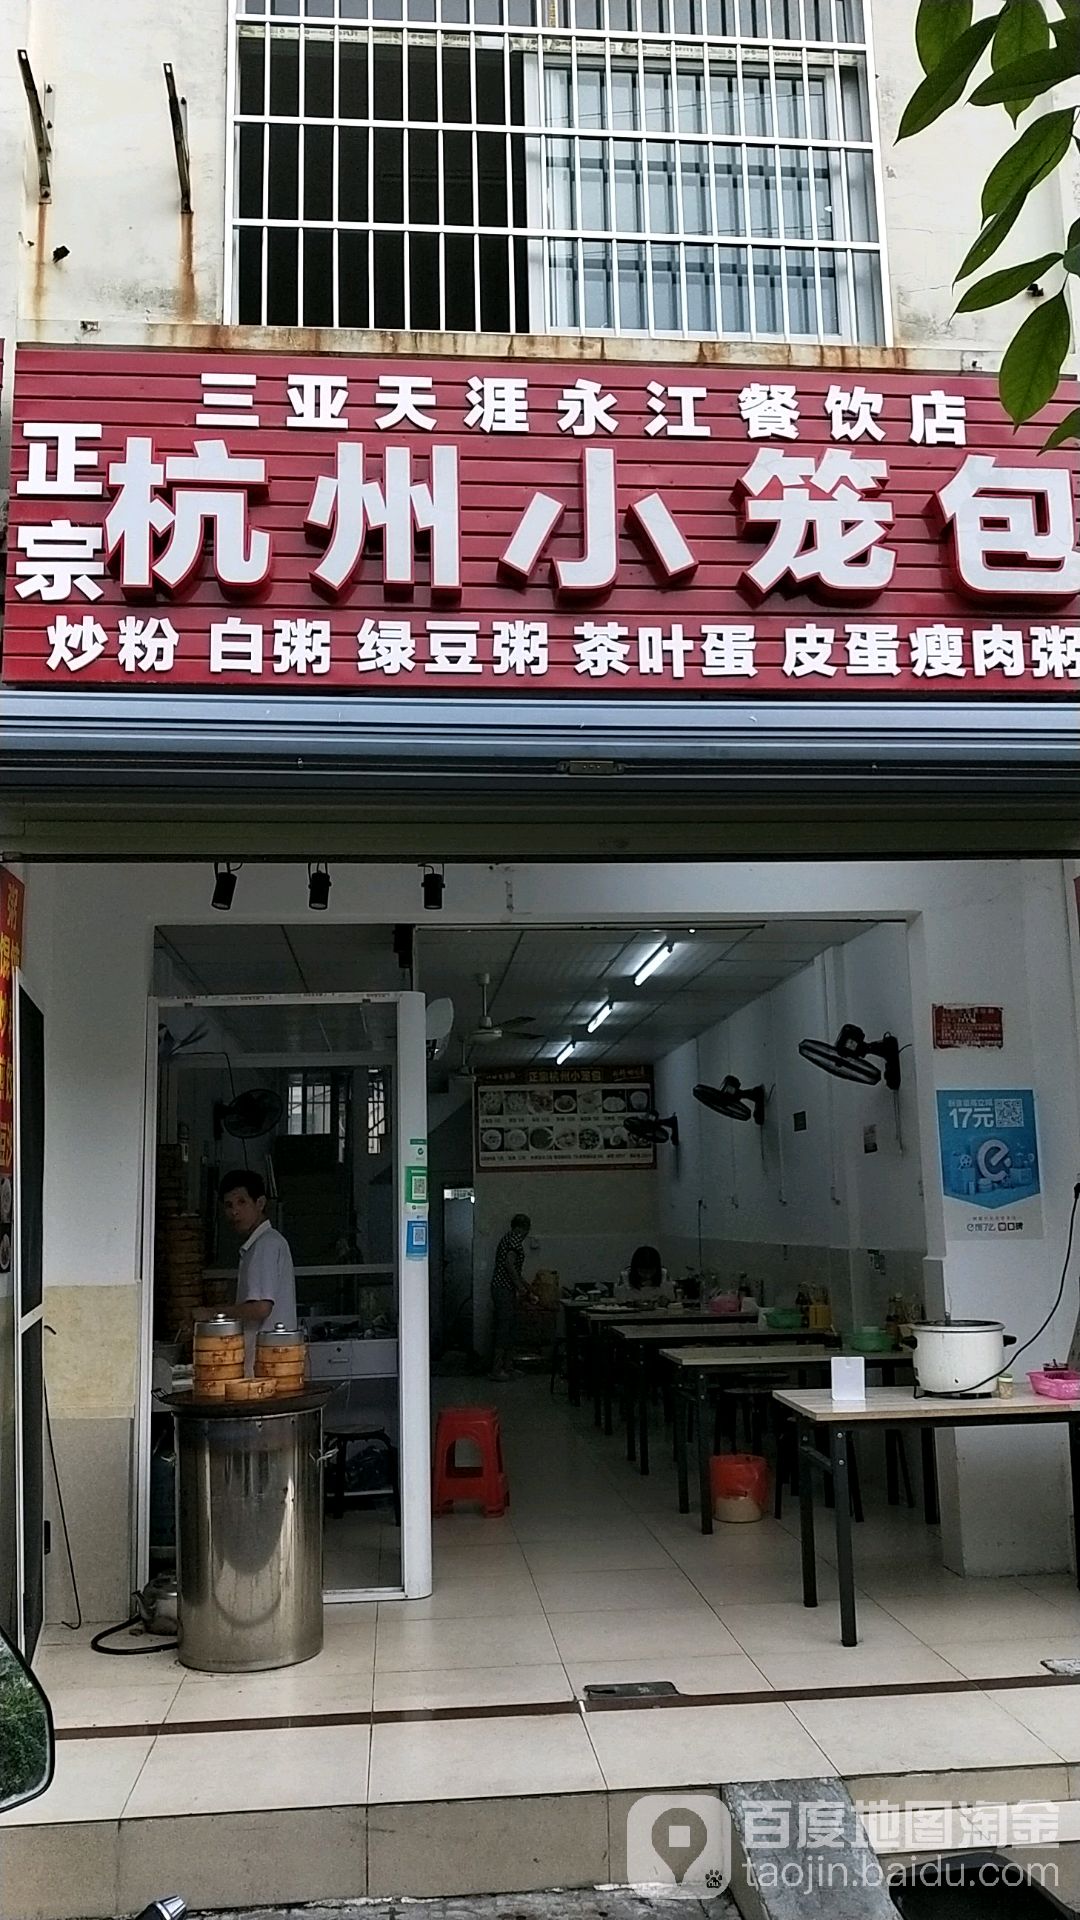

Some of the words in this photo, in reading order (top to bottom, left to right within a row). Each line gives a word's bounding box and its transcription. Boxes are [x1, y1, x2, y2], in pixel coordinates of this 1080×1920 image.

[195, 372, 967, 446] 三亚天涯永江餐饮店
[14, 422, 105, 602] 正宗
[103, 435, 1080, 600] 杭州小笼包
[46, 614, 181, 673] 炒粉
[209, 617, 332, 675] 白粥
[356, 618, 549, 676] 绿豆粥
[573, 621, 759, 679] 茶叶蛋
[782, 622, 1080, 679] 皮蛋瘦肉粥
[949, 1107, 994, 1128] 17元
